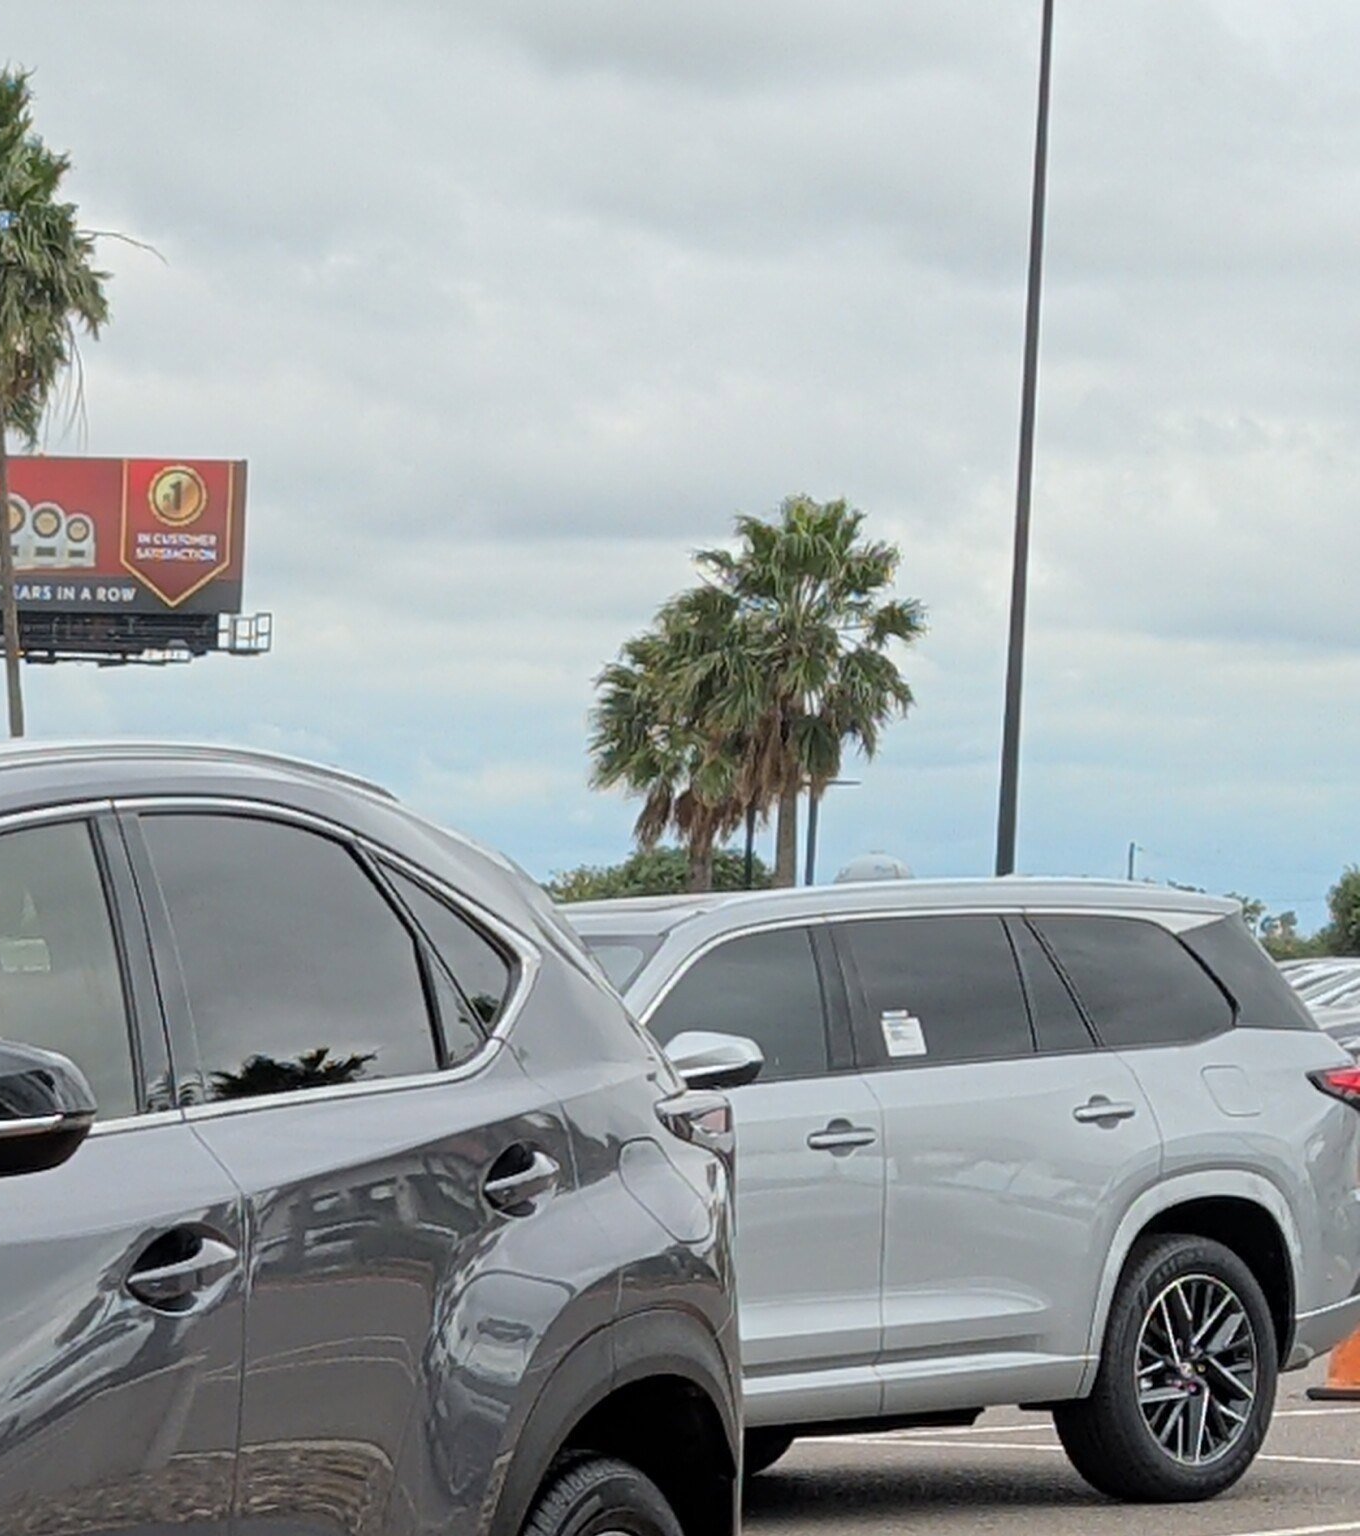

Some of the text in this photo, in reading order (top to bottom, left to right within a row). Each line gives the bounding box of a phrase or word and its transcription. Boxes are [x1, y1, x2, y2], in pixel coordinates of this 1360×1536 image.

[153, 533, 217, 546] CUSTOMER
[57, 585, 75, 600] IN
[79, 586, 93, 600] A
[95, 586, 137, 602] ROW
